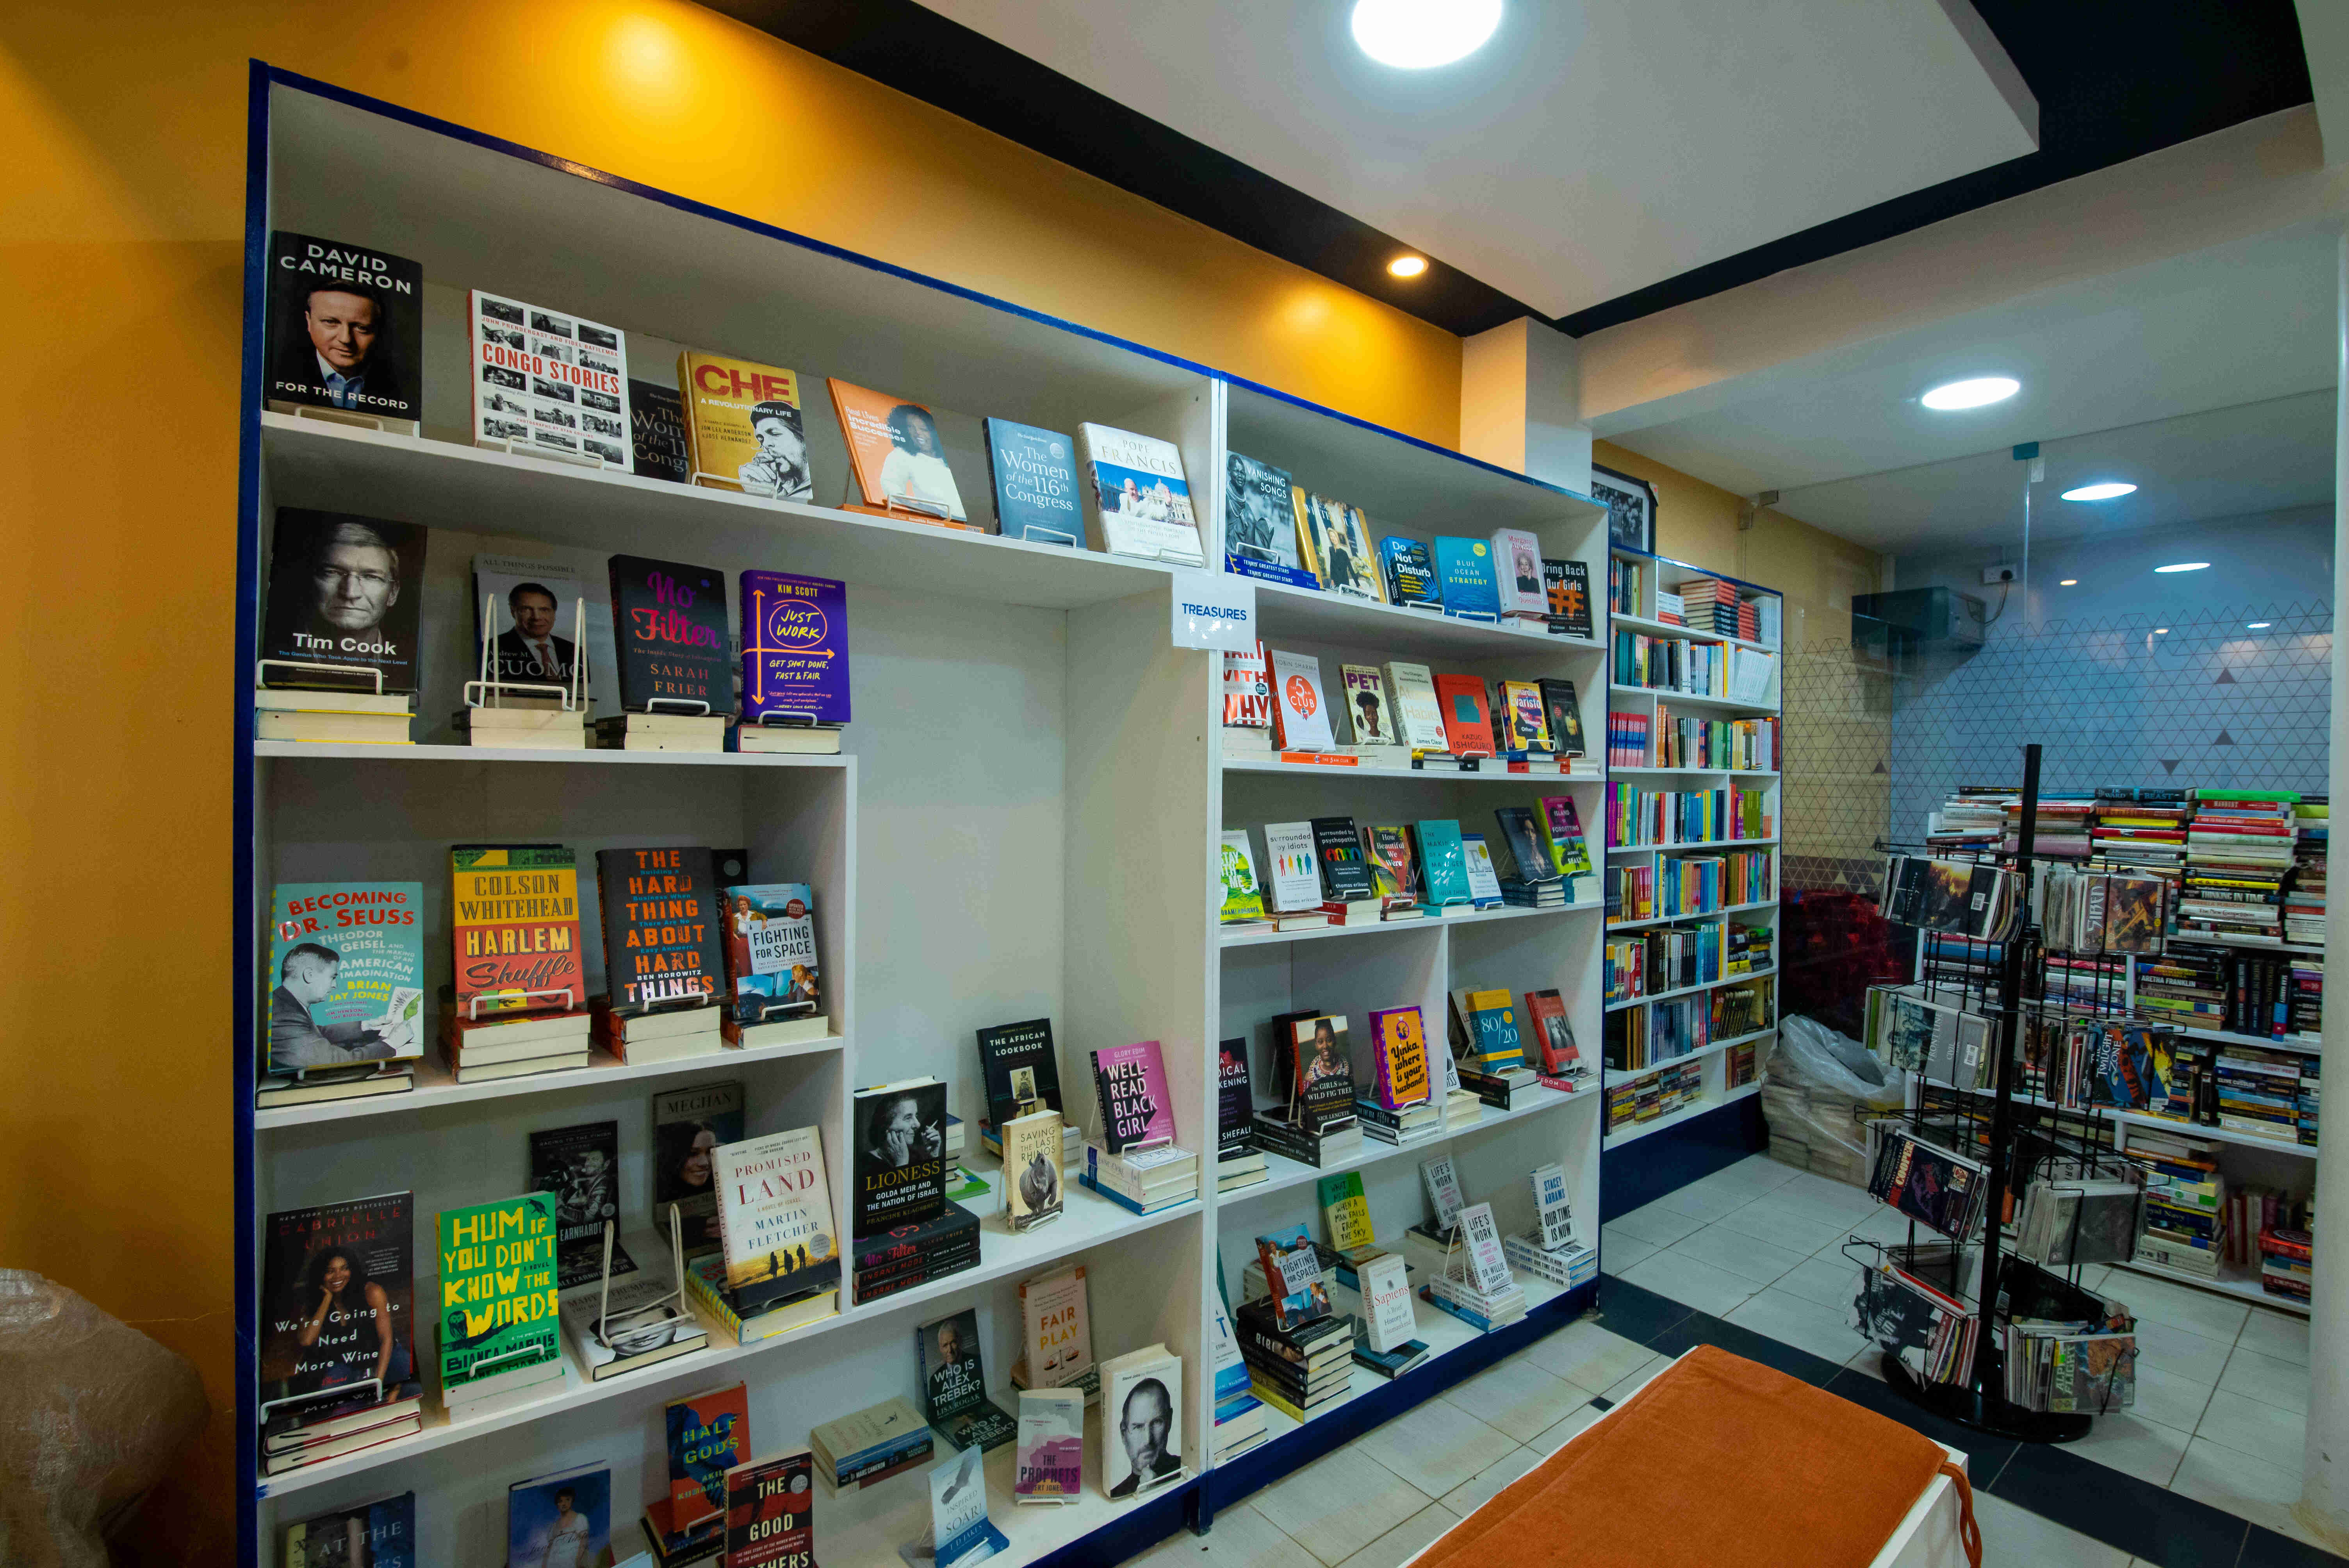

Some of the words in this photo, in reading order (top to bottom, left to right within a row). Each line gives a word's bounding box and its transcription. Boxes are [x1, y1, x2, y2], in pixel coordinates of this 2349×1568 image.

[307, 245, 387, 271] DAVID
[280, 256, 411, 294] CAMERON
[482, 343, 542, 375] CONGO
[551, 362, 620, 395] STORIES
[695, 365, 792, 405] CHE
[276, 381, 307, 393] FOR
[314, 387, 341, 398] THE
[350, 392, 408, 410] RECORD
[709, 400, 773, 414] REVOLUTIONARY
[1024, 446, 1047, 461] The
[1001, 449, 1069, 480] Women
[1006, 472, 1017, 481] of
[1018, 474, 1032, 485] the
[1246, 466, 1285, 487] VANISHING
[1006, 483, 1073, 511] Congress
[1260, 483, 1286, 499] SONGS
[1392, 541, 1406, 552] Do
[1259, 563, 1277, 571] GREATEST
[1395, 554, 1411, 563] Not
[1397, 563, 1431, 577] Disturb
[647, 572, 696, 608] No
[778, 584, 792, 594] KIM
[795, 586, 818, 597] SCOTT
[1449, 577, 1487, 585] STRATEGY
[781, 609, 820, 623] JUST
[1182, 603, 1246, 620] TREASURES
[632, 608, 721, 649] Filter
[776, 625, 820, 639] WORK
[293, 633, 332, 650] Tim
[340, 636, 397, 655] Cook
[651, 663, 709, 680] SARAH
[1346, 672, 1380, 690] PET
[655, 681, 708, 696] FRIER
[1290, 696, 1315, 708] CLUB
[635, 851, 680, 869] THE
[474, 875, 560, 896] COLSON
[629, 875, 692, 894] HARD
[288, 892, 407, 916] BECOMING
[460, 897, 573, 920] WHITEHEAD
[626, 900, 698, 921] THING
[279, 916, 330, 942] DR.
[337, 908, 414, 927] SEUSS
[319, 930, 383, 946] THEODOR
[466, 927, 572, 957] HARLEM
[627, 925, 704, 947] ABOUT
[754, 926, 809, 945] FIGHTING
[341, 939, 386, 953] GEISEL
[756, 949, 772, 959] FOR
[775, 941, 811, 958] SPACE
[339, 959, 414, 973] AMERICAN
[465, 955, 576, 988] Shuffle
[635, 951, 700, 973] HARD
[340, 972, 411, 982] IMAGINATION
[658, 969, 701, 979] HOROWITZ
[2165, 978, 2196, 987] FRANKLIN
[330, 992, 349, 1001] JAY
[353, 990, 388, 1001] JONES
[348, 980, 392, 991] BRIAN
[625, 976, 713, 1002] THINGS
[990, 1038, 1005, 1046] THE
[1009, 1030, 1046, 1044] AFRICAN
[1928, 1034, 1939, 1062] FRONT
[1934, 1011, 1942, 1031] LINE
[996, 1043, 1043, 1056] LOOKBOOK
[1391, 1044, 1419, 1059] Yinka,
[2096, 1032, 2113, 1078] TWILIGHT
[2108, 1041, 2122, 1072] ZONE
[1107, 1061, 1148, 1081] WELL-
[1395, 1055, 1420, 1070] where
[1395, 1073, 1425, 1095] huzband?
[1396, 1073, 1402, 1083] is
[1404, 1065, 1422, 1081] your
[1110, 1078, 1146, 1098] READ
[1114, 1095, 1157, 1119] BLACK
[1021, 1127, 1055, 1142] SAVING
[1117, 1119, 1148, 1137] GIRL
[1036, 1137, 1055, 1150] LAST
[1021, 1146, 1055, 1162] RHINOS
[1895, 1140, 1915, 1185] COOPER
[735, 1151, 811, 1178] PROMISED
[866, 1161, 939, 1190] LIONESS
[1543, 1176, 1562, 1191] STACEY
[737, 1169, 814, 1206] LAND
[876, 1187, 896, 1199] GOLDA
[900, 1183, 916, 1194] MEIR
[918, 1181, 930, 1189] AND
[1545, 1188, 1565, 1205] ABRAMS
[867, 1202, 879, 1211] THE
[882, 1197, 905, 1208] NATION
[918, 1188, 938, 1199] ISRAEL
[756, 1208, 807, 1231] MARTIN
[1469, 1214, 1489, 1231] LIFE'S
[1545, 1211, 1557, 1226] OUR
[1558, 1205, 1571, 1222] TIME
[453, 1207, 524, 1247] HUM
[531, 1217, 548, 1234] IF
[748, 1221, 818, 1249] FLETCHER
[1472, 1227, 1493, 1244] WORK
[1551, 1229, 1558, 1242] IS
[1559, 1223, 1571, 1239] NOW
[444, 1245, 487, 1274] YOU
[495, 1235, 556, 1269] DON'T
[951, 1242, 971, 1251] McKENZIE
[444, 1267, 519, 1307] KNOW
[524, 1271, 550, 1289] THE
[1375, 1285, 1408, 1308] Sapiens
[275, 1316, 319, 1332] We're
[330, 1307, 377, 1323] Going
[387, 1303, 399, 1312] to
[465, 1289, 558, 1338] WORDS
[1041, 1306, 1075, 1331] FAIR
[318, 1331, 357, 1347] Need
[1040, 1324, 1078, 1350] PLAY
[295, 1358, 335, 1374] More
[343, 1350, 378, 1363] Wine
[934, 1365, 961, 1383] WHO
[961, 1360, 975, 1371] IS
[942, 1373, 970, 1392] ALEX
[933, 1380, 980, 1407] TREBEK?
[683, 1417, 737, 1443] HALF
[684, 1437, 739, 1464] GODS
[757, 1476, 785, 1499] THE
[750, 1513, 793, 1541] GOOD
